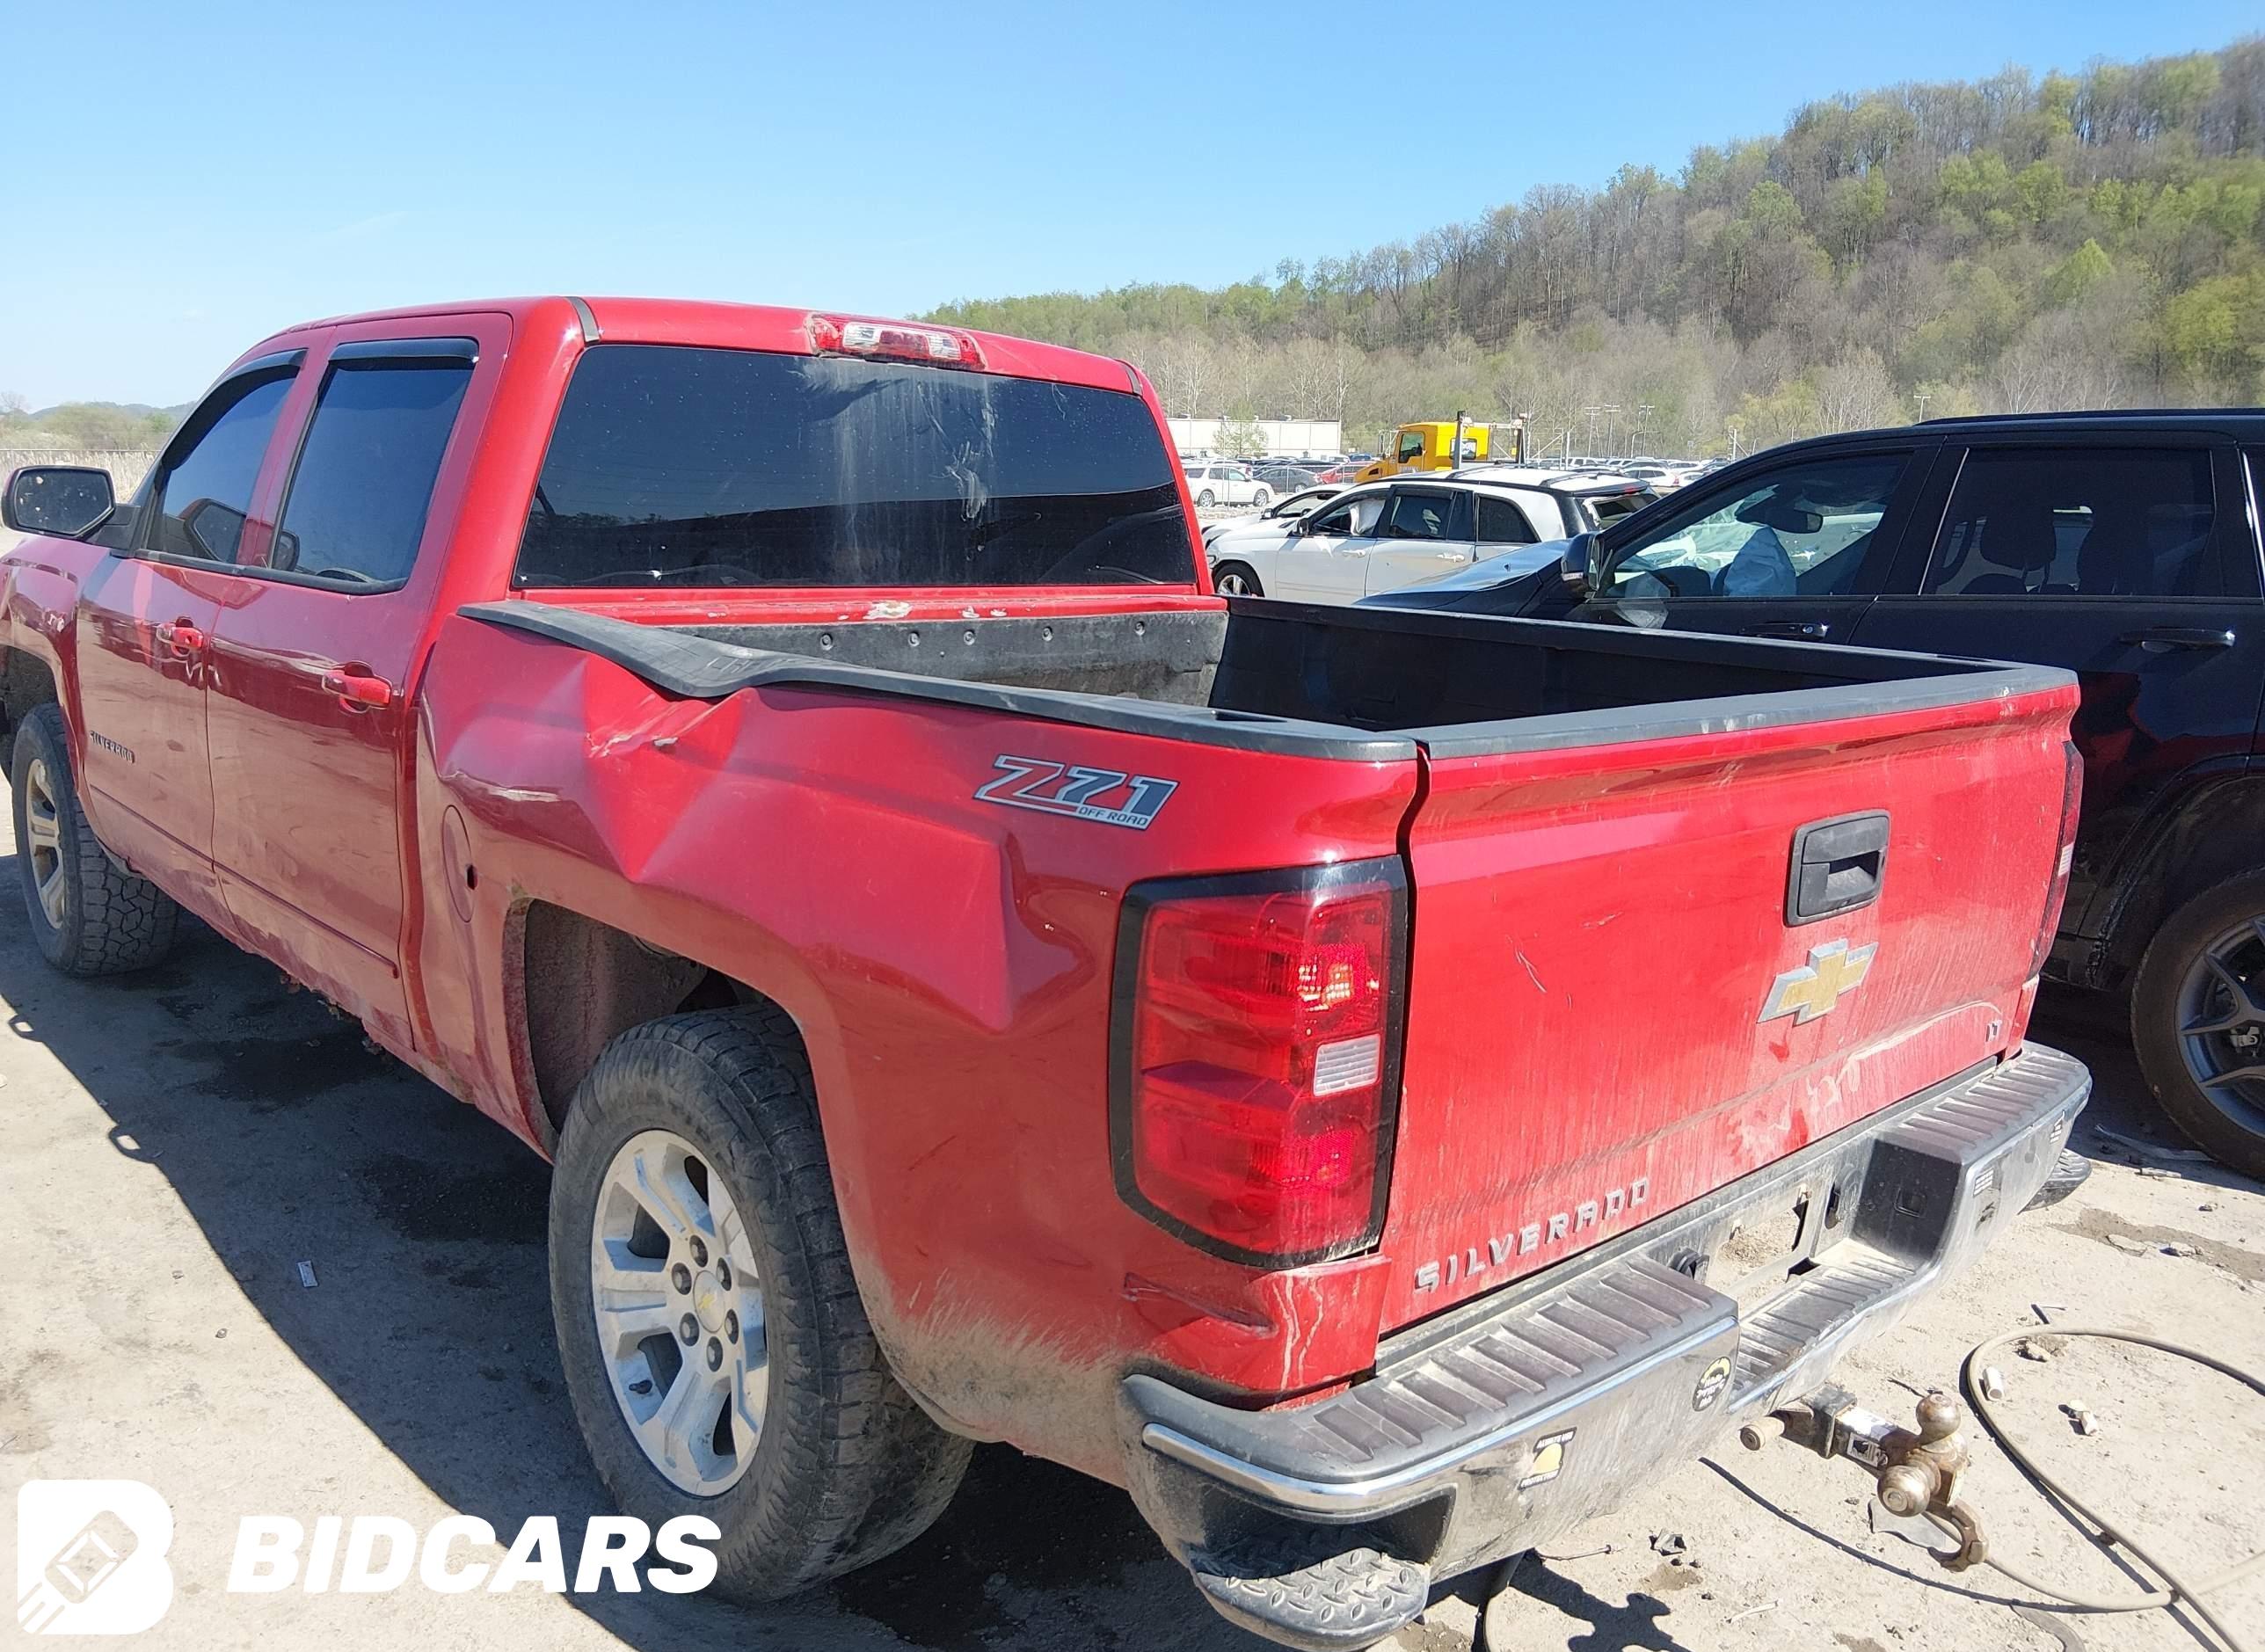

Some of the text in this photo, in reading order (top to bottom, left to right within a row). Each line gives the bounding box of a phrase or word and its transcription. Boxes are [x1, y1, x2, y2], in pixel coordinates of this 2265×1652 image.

[973, 753, 1180, 818] Z71
[1078, 804, 1148, 827] OFF ROAD
[1414, 1177, 1650, 1294] SILVERADO
